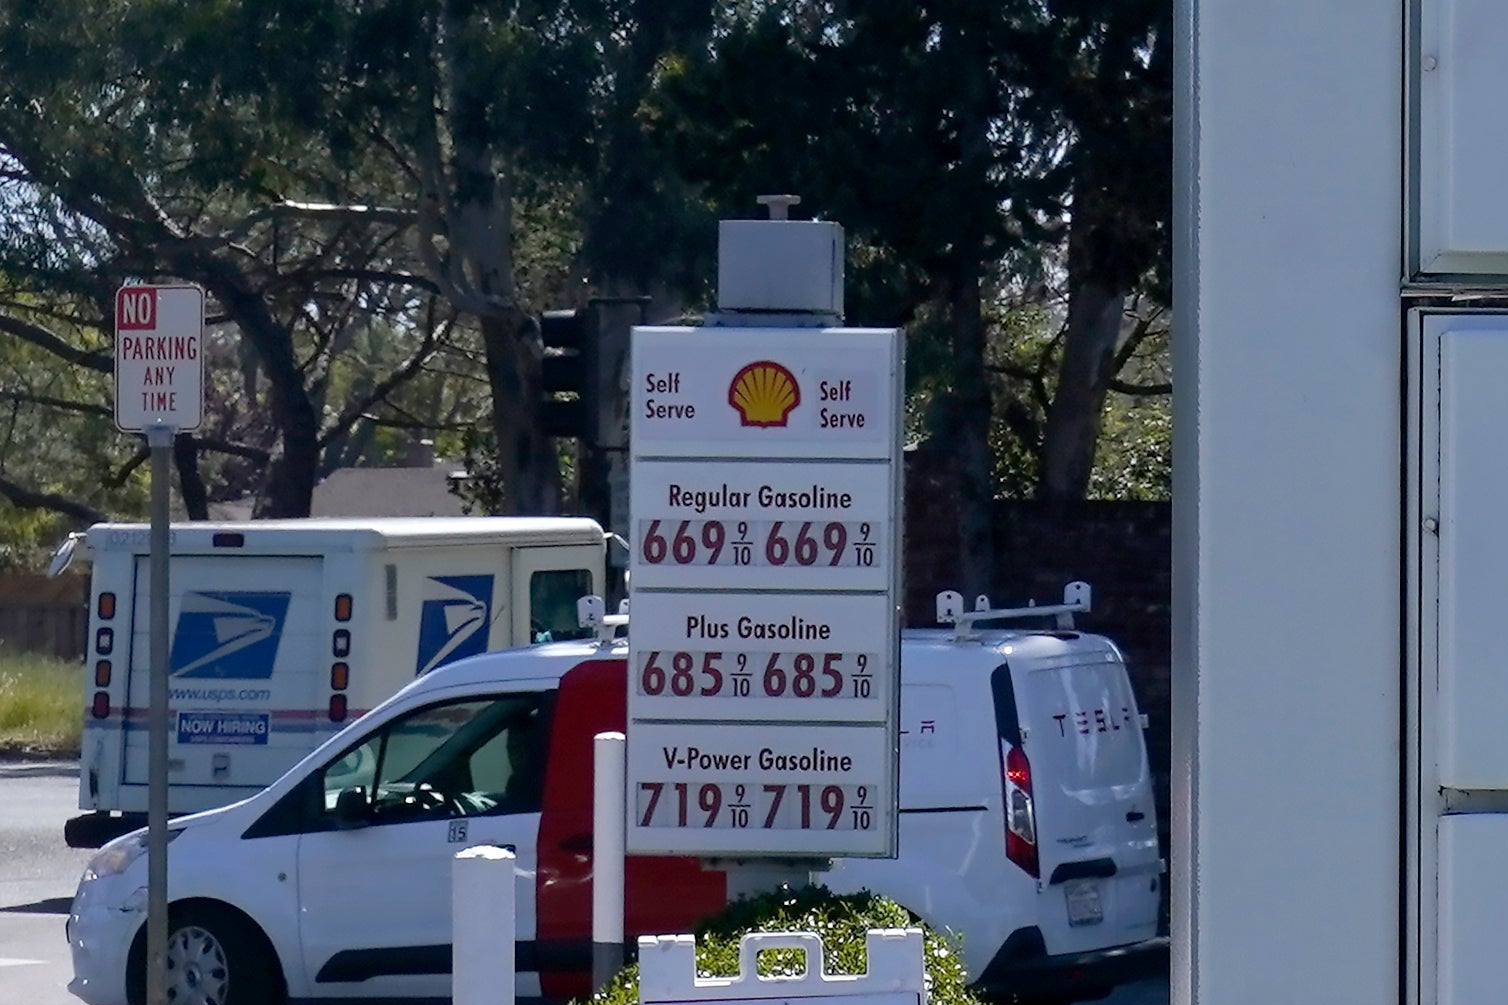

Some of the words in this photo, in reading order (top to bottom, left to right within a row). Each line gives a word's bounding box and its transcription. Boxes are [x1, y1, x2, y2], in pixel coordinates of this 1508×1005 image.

[122, 292, 152, 324] NO
[122, 336, 198, 361] PARKING
[143, 366, 176, 386] ANY
[645, 372, 680, 394] Self
[142, 392, 177, 412] TIME
[819, 380, 852, 401] Self
[645, 399, 696, 419] Serve
[819, 408, 866, 429] Serve
[669, 484, 751, 513] Regular
[758, 485, 852, 509] Gasoline
[643, 519, 726, 565] 669
[765, 521, 848, 567] 669
[686, 615, 729, 639] Plus
[737, 616, 832, 640] Gasoline
[642, 651, 724, 697] 685
[763, 652, 844, 698] 685
[181, 719, 215, 733] NOW
[217, 720, 266, 734] HIRING
[663, 747, 752, 771] V-Power
[758, 748, 852, 772] Gasoline
[641, 782, 723, 829] 719
[763, 784, 845, 830] 719
